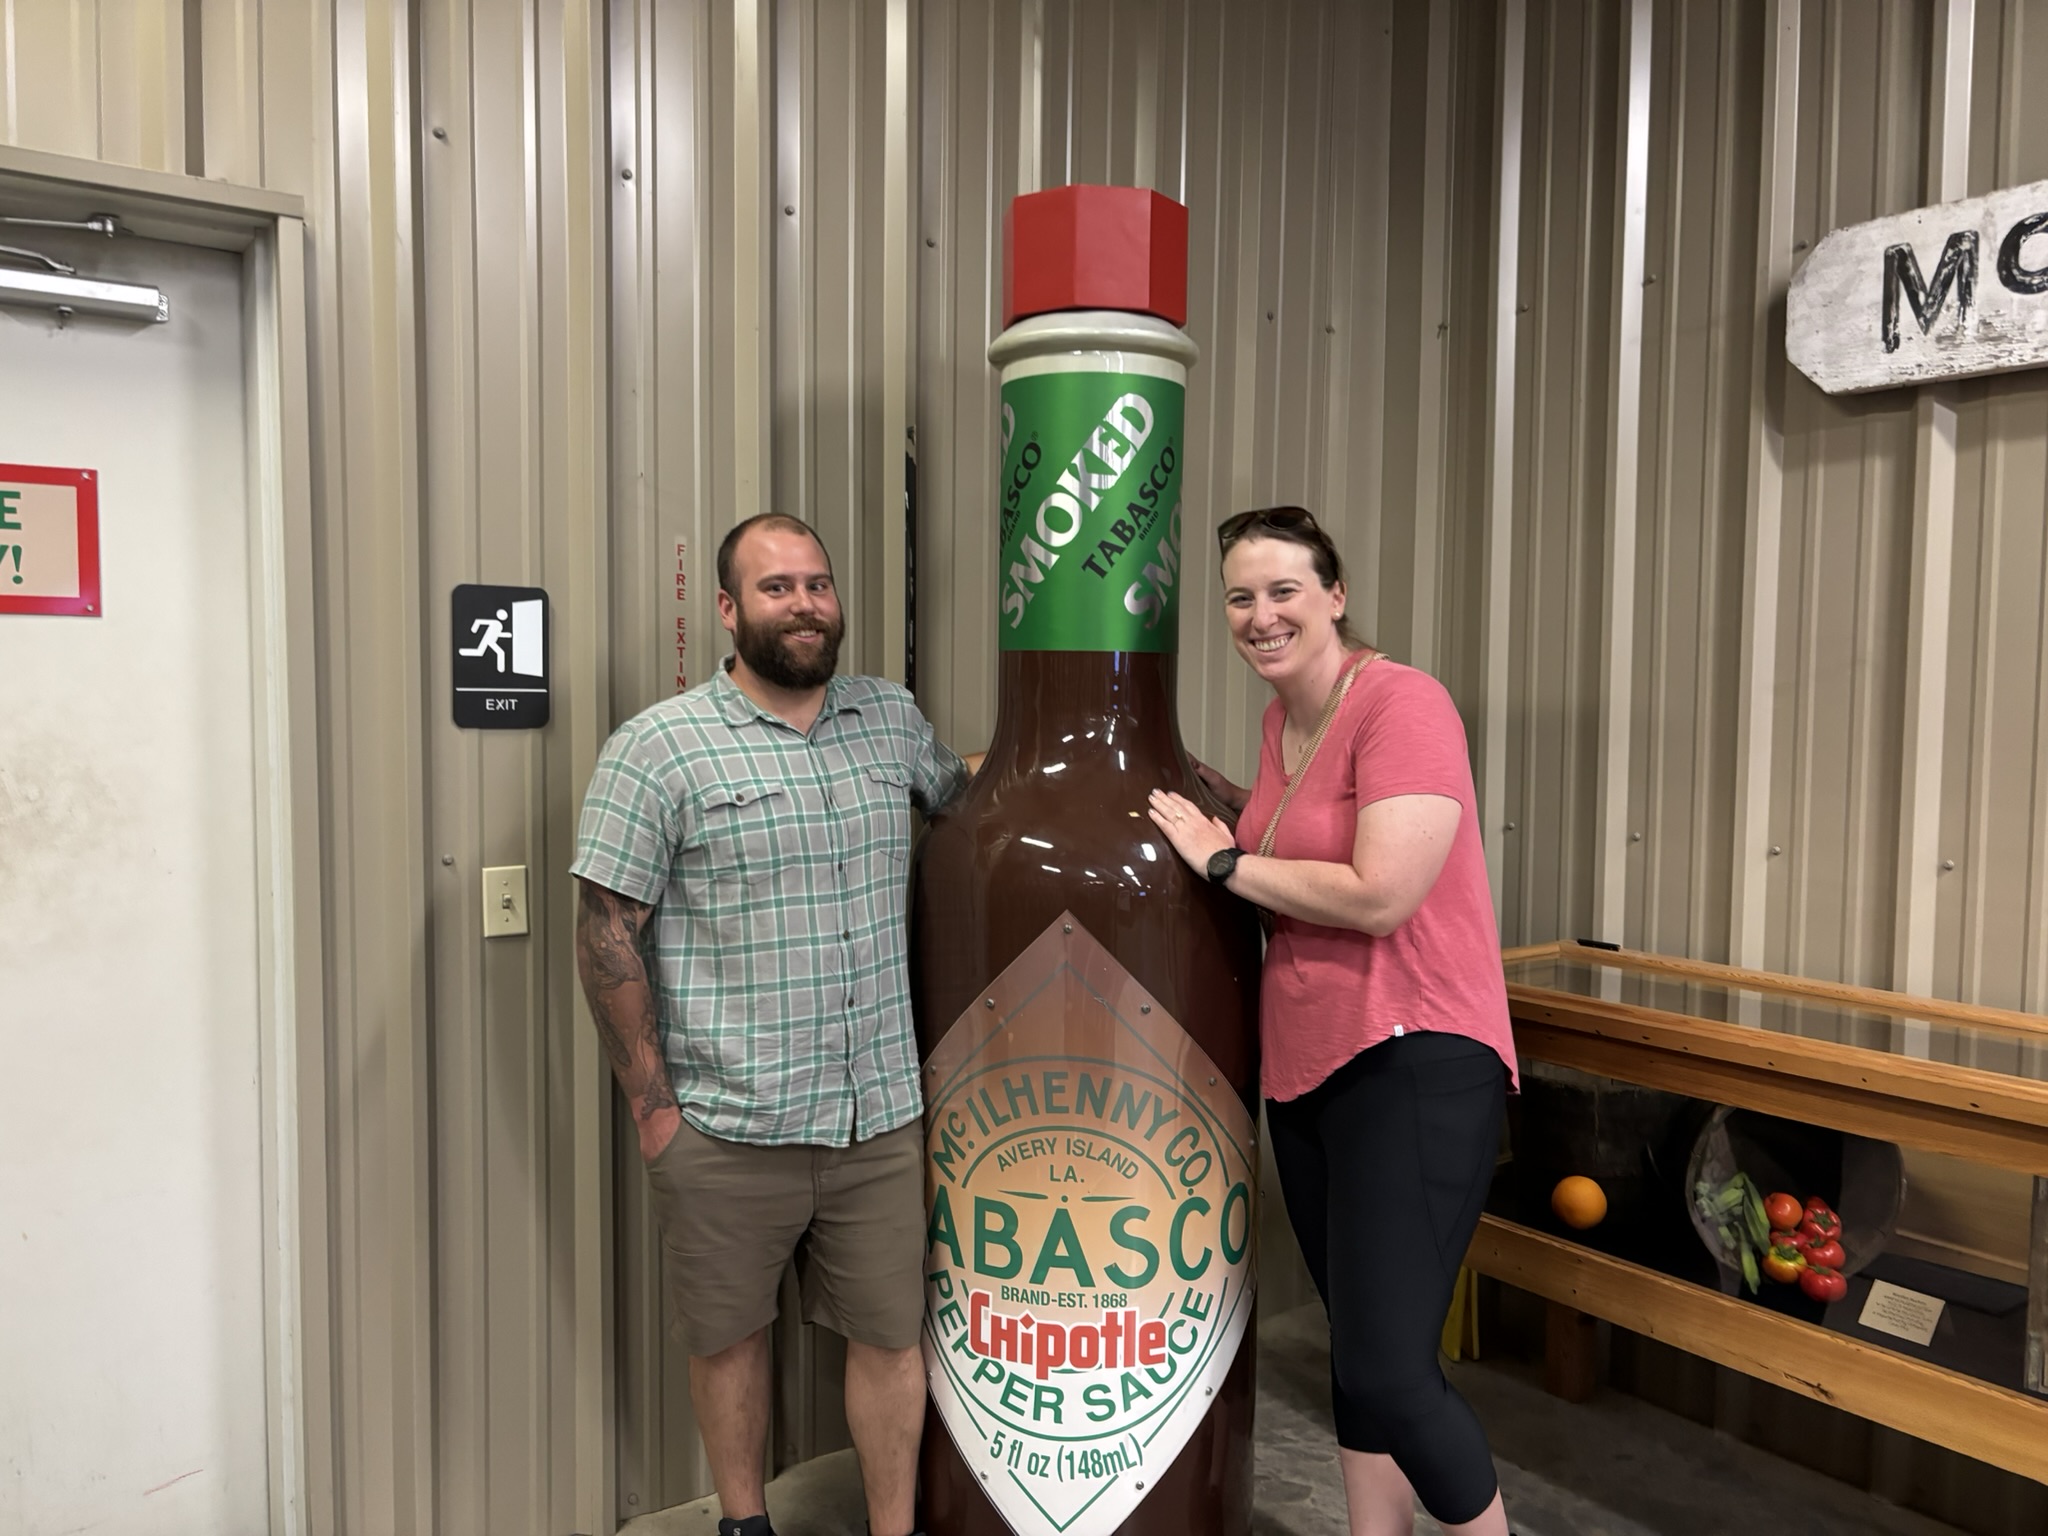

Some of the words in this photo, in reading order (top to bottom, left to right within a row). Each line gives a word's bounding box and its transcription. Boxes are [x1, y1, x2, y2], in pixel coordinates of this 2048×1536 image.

[1002, 393, 1154, 629] SMOKED
[1081, 446, 1175, 579] TABASCO
[1138, 511, 1159, 541] BRAND
[676, 544, 686, 600] FIRE
[485, 699, 518, 711] EXIT
[997, 1137, 1057, 1172] AVERY
[1066, 1138, 1139, 1180] ISLAND
[1050, 1165, 1085, 1183] LA.
[928, 1182, 1249, 1289] ABASCO
[1092, 1293, 1128, 1308] 1868
[990, 1430, 1006, 1459] 5
[1007, 1439, 1023, 1470] fl
[1027, 1452, 1049, 1478] oz
[1056, 1433, 1144, 1482] (148mL)
